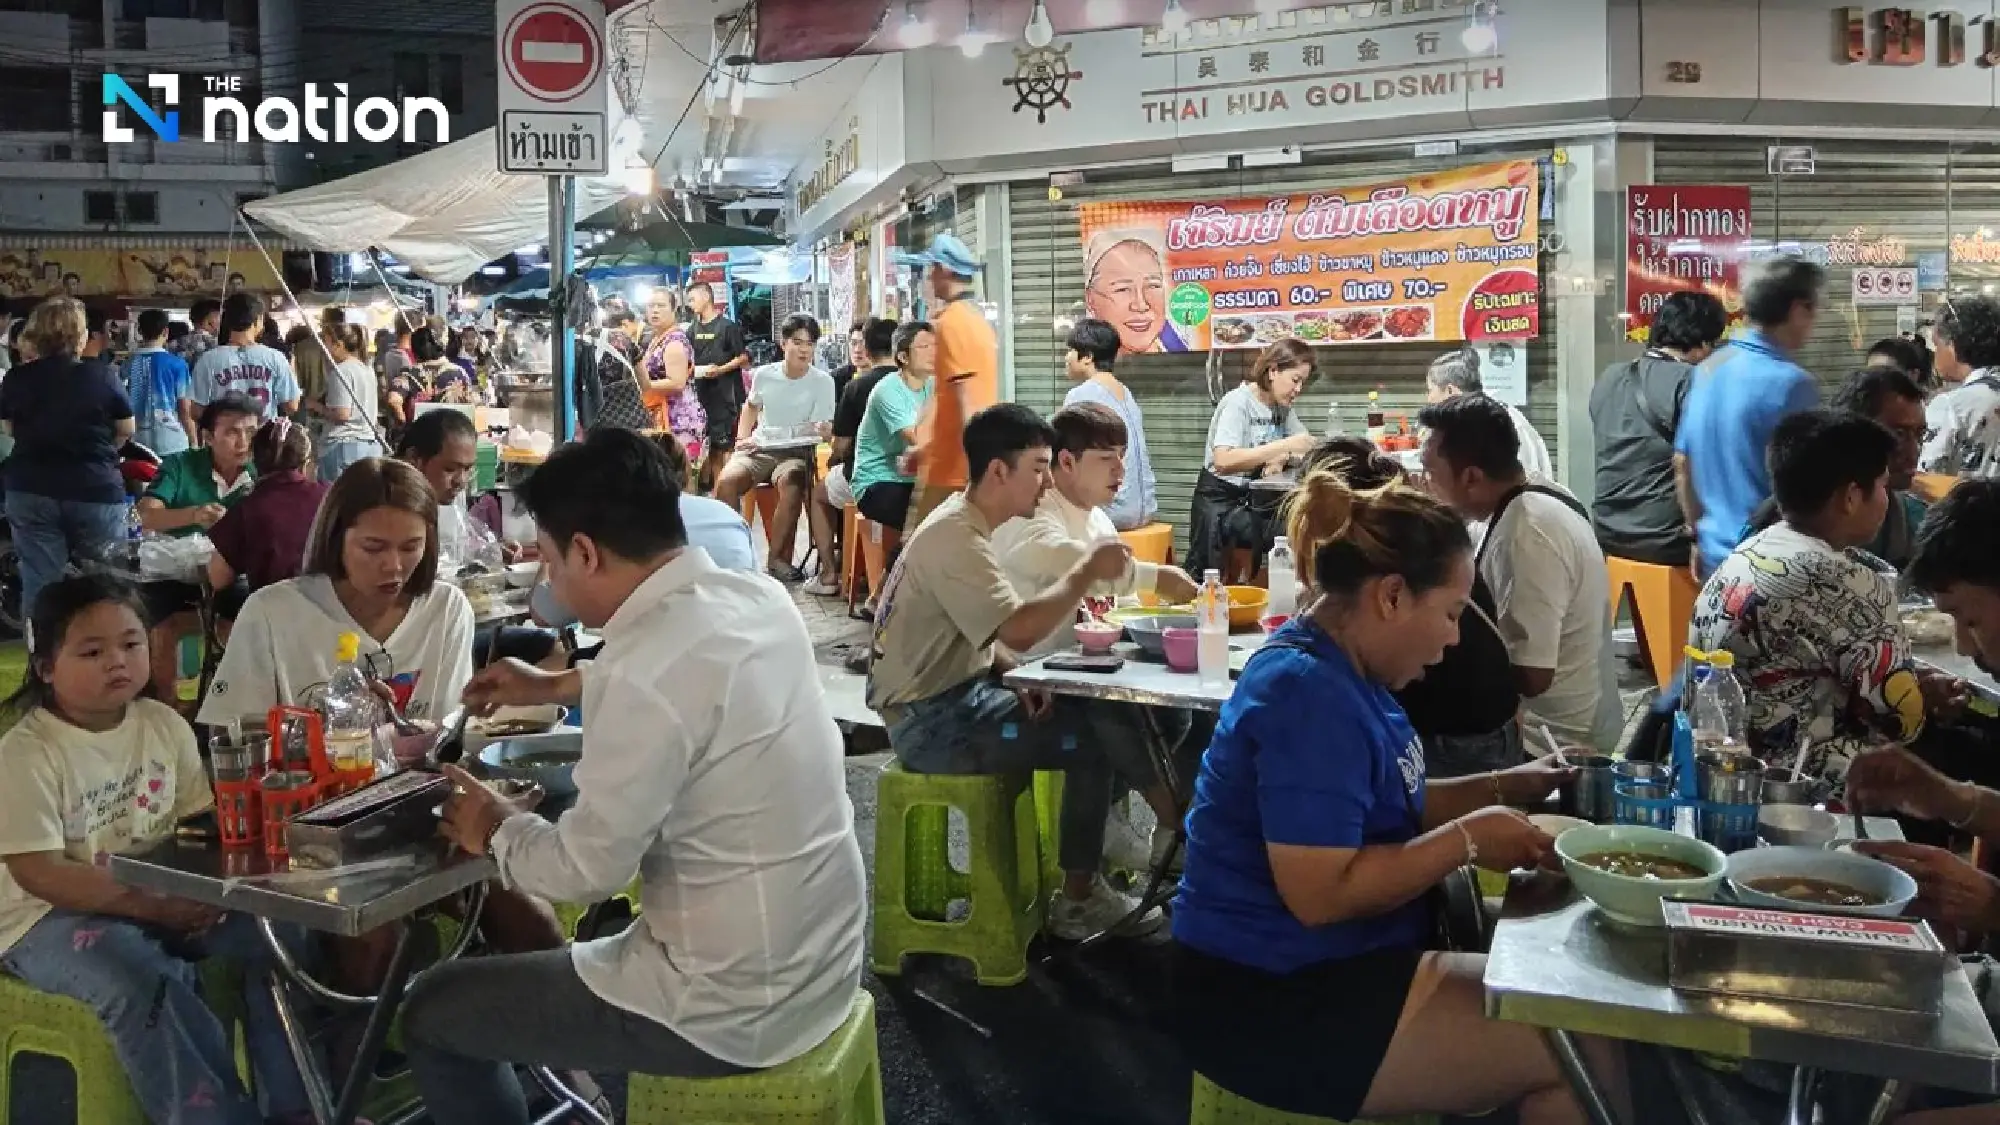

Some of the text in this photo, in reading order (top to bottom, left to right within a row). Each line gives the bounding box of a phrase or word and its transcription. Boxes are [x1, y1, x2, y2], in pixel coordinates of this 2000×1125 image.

[1665, 61, 1701, 83] 29
[1142, 66, 1504, 123] THAI HUA GOLDSMITH
[509, 121, 596, 160] ห้ามเข้า
[1294, 186, 1530, 242] ต้มเลือดหมู
[1633, 192, 1746, 236] รับฝากทอง
[1380, 248, 1450, 270] ข้าวหมูแดง
[1455, 242, 1535, 266] ข้าวหมูกรอบ
[1636, 241, 1724, 288] ให้ราคาสูง
[1213, 288, 1281, 308] ธรรมดา
[1290, 285, 1333, 305] 60.-
[1342, 278, 1394, 302] พิเศษ
[1402, 279, 1447, 299] 70.-
[1474, 290, 1537, 310] รับเฉพาะ
[1484, 314, 1530, 333] เงินสด
[214, 364, 273, 387] CARLTON
[1737, 911, 1866, 930] CASH ONLY
